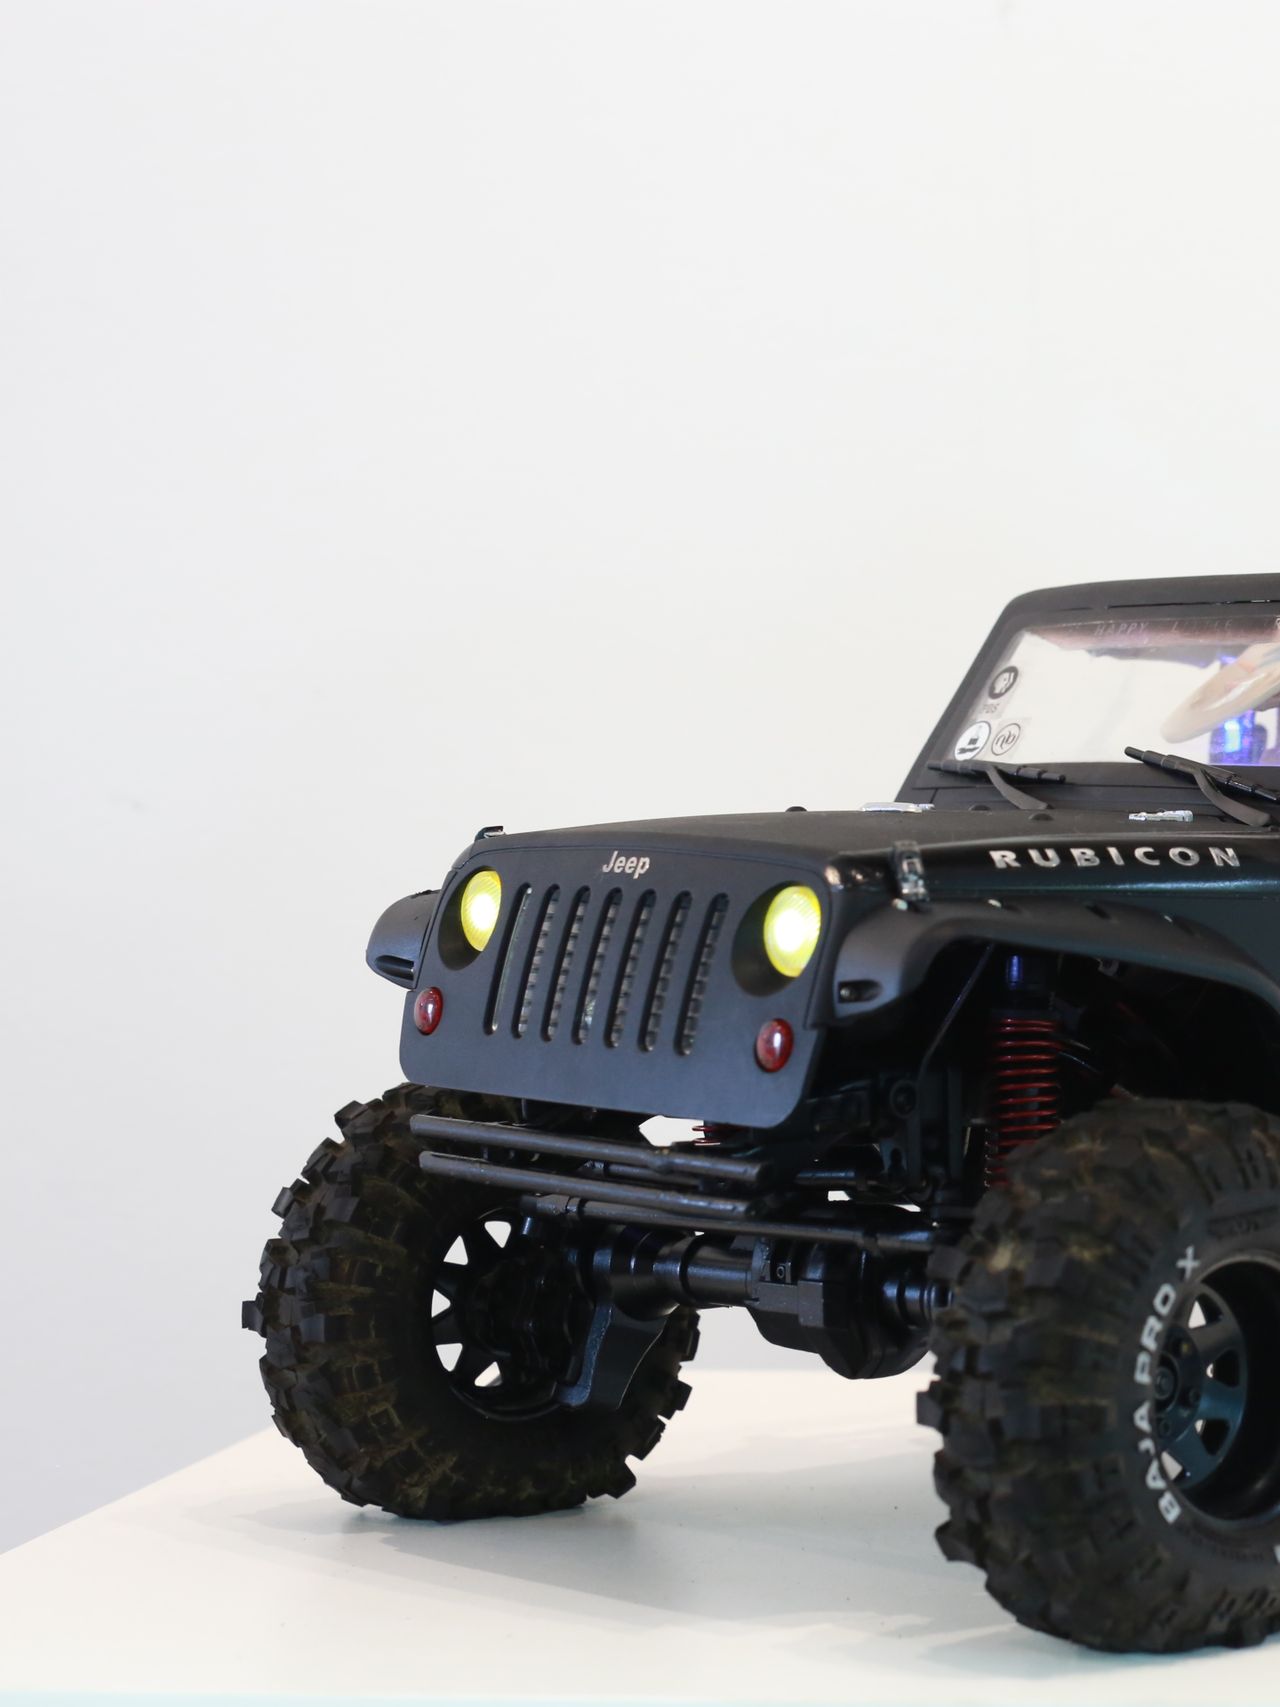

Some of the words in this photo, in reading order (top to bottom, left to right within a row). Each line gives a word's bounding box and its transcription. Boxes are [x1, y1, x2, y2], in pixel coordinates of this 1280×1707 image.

[1094, 621, 1149, 636] HAPPY
[602, 850, 651, 879] Jeep
[988, 846, 1241, 869] RUBICON
[1175, 1245, 1201, 1281] X
[1133, 1282, 1177, 1385] PRO
[1132, 1401, 1183, 1525] BAJA
